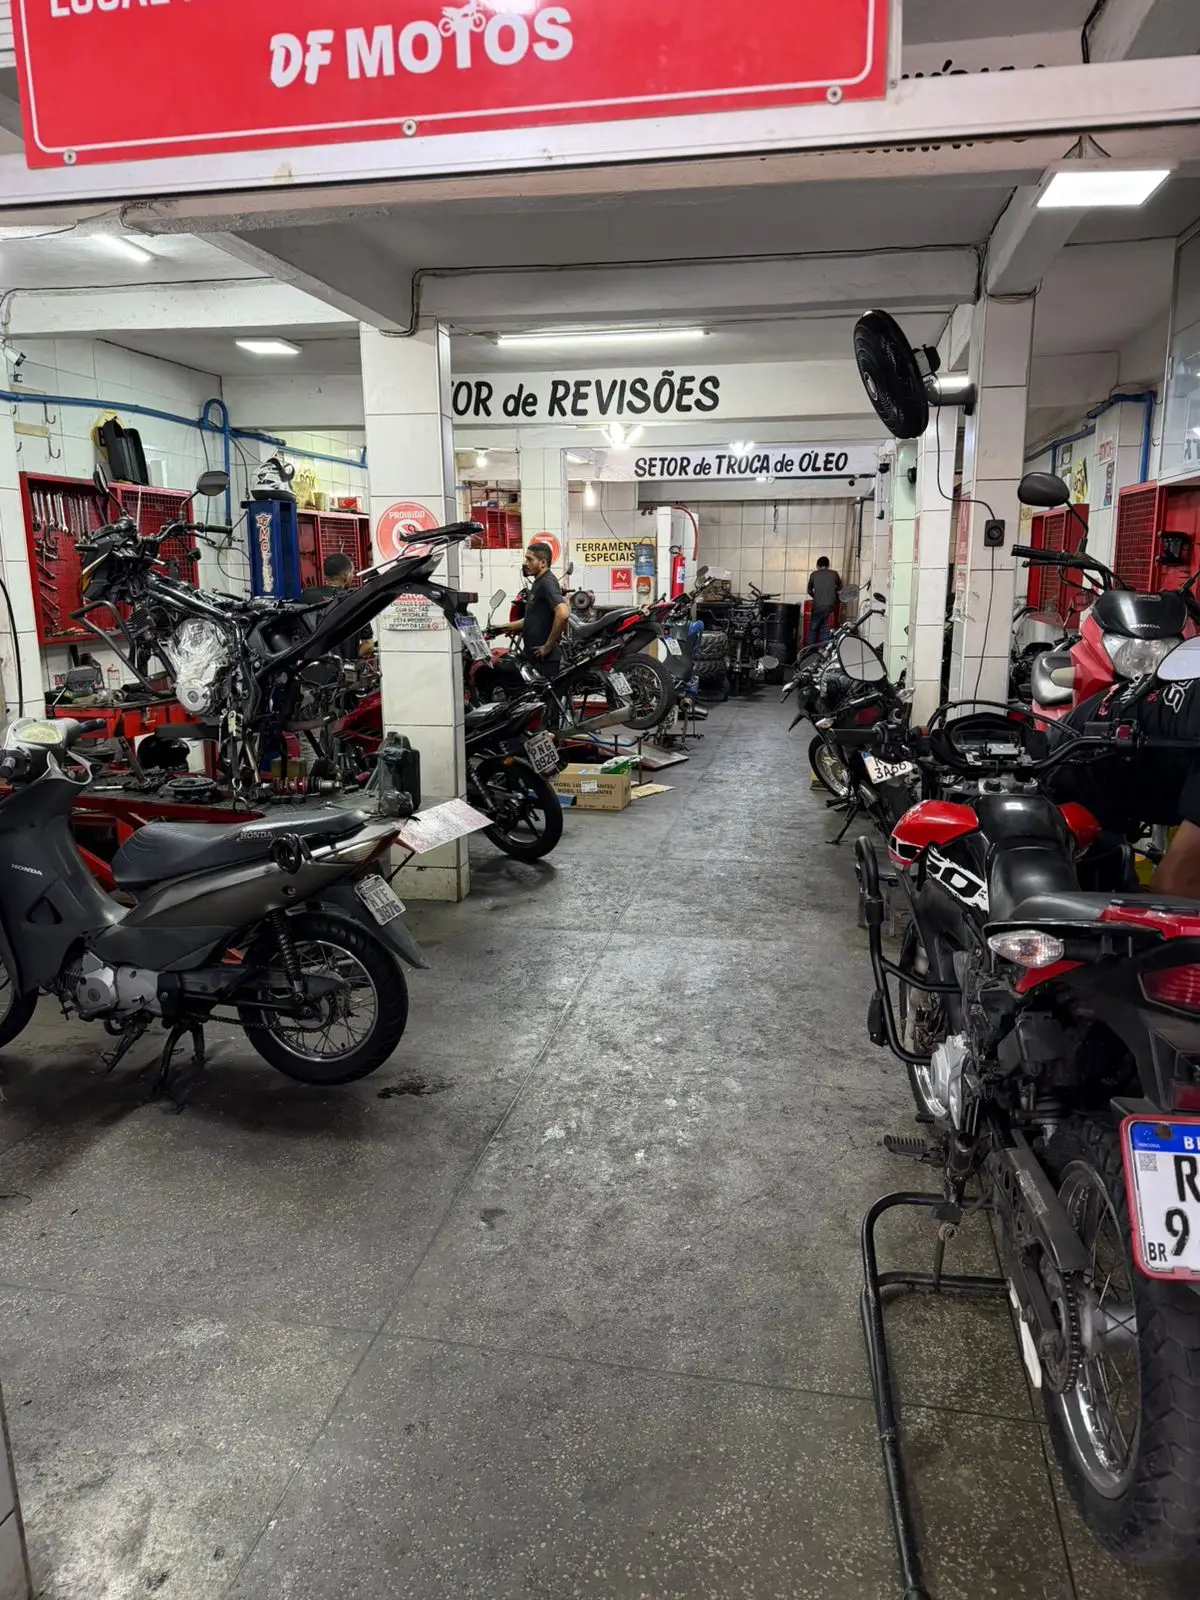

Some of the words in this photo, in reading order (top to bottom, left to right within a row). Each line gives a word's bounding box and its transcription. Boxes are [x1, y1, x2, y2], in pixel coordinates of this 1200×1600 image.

[270, 29, 334, 88] DF
[345, 6, 574, 81] MOTOS
[451, 381, 494, 417] OR
[502, 383, 538, 417] de
[547, 369, 720, 418] REVISÕES
[634, 456, 691, 477] SETOR
[692, 456, 712, 476] de
[715, 454, 770, 474] TROCA
[774, 453, 794, 473] de
[798, 450, 849, 472] ÓLEO
[389, 510, 425, 519] PROIBIDO
[576, 541, 637, 552] FERRAMENT
[585, 552, 636, 562] ESPECIAIS
[532, 740, 551, 760] PNG
[535, 750, 557, 771] 8928
[240, 831, 273, 839] HONDA
[11, 863, 43, 876] HONDA
[1148, 1243, 1168, 1262] BR
[1165, 1209, 1190, 1257] 9
